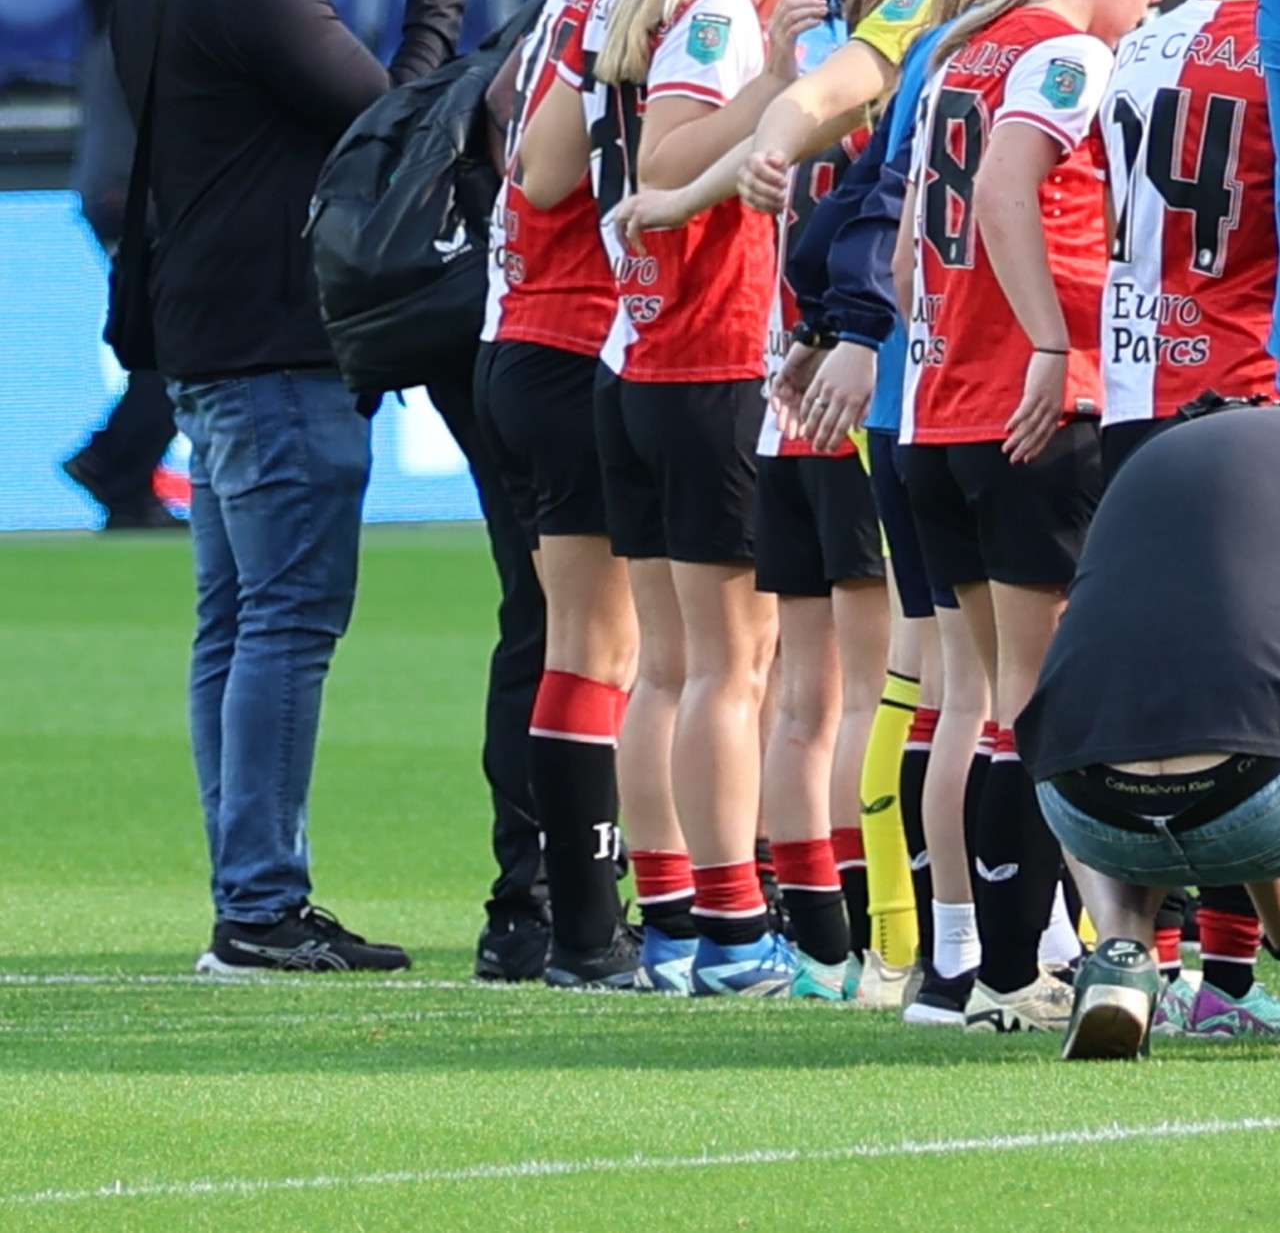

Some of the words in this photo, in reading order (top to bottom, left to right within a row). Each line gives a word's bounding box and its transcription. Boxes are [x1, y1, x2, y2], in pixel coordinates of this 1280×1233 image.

[1117, 33, 1157, 70] DE
[1110, 87, 1247, 279] 14
[1112, 282, 1200, 325] Euro
[1111, 326, 1210, 365] Parcs
